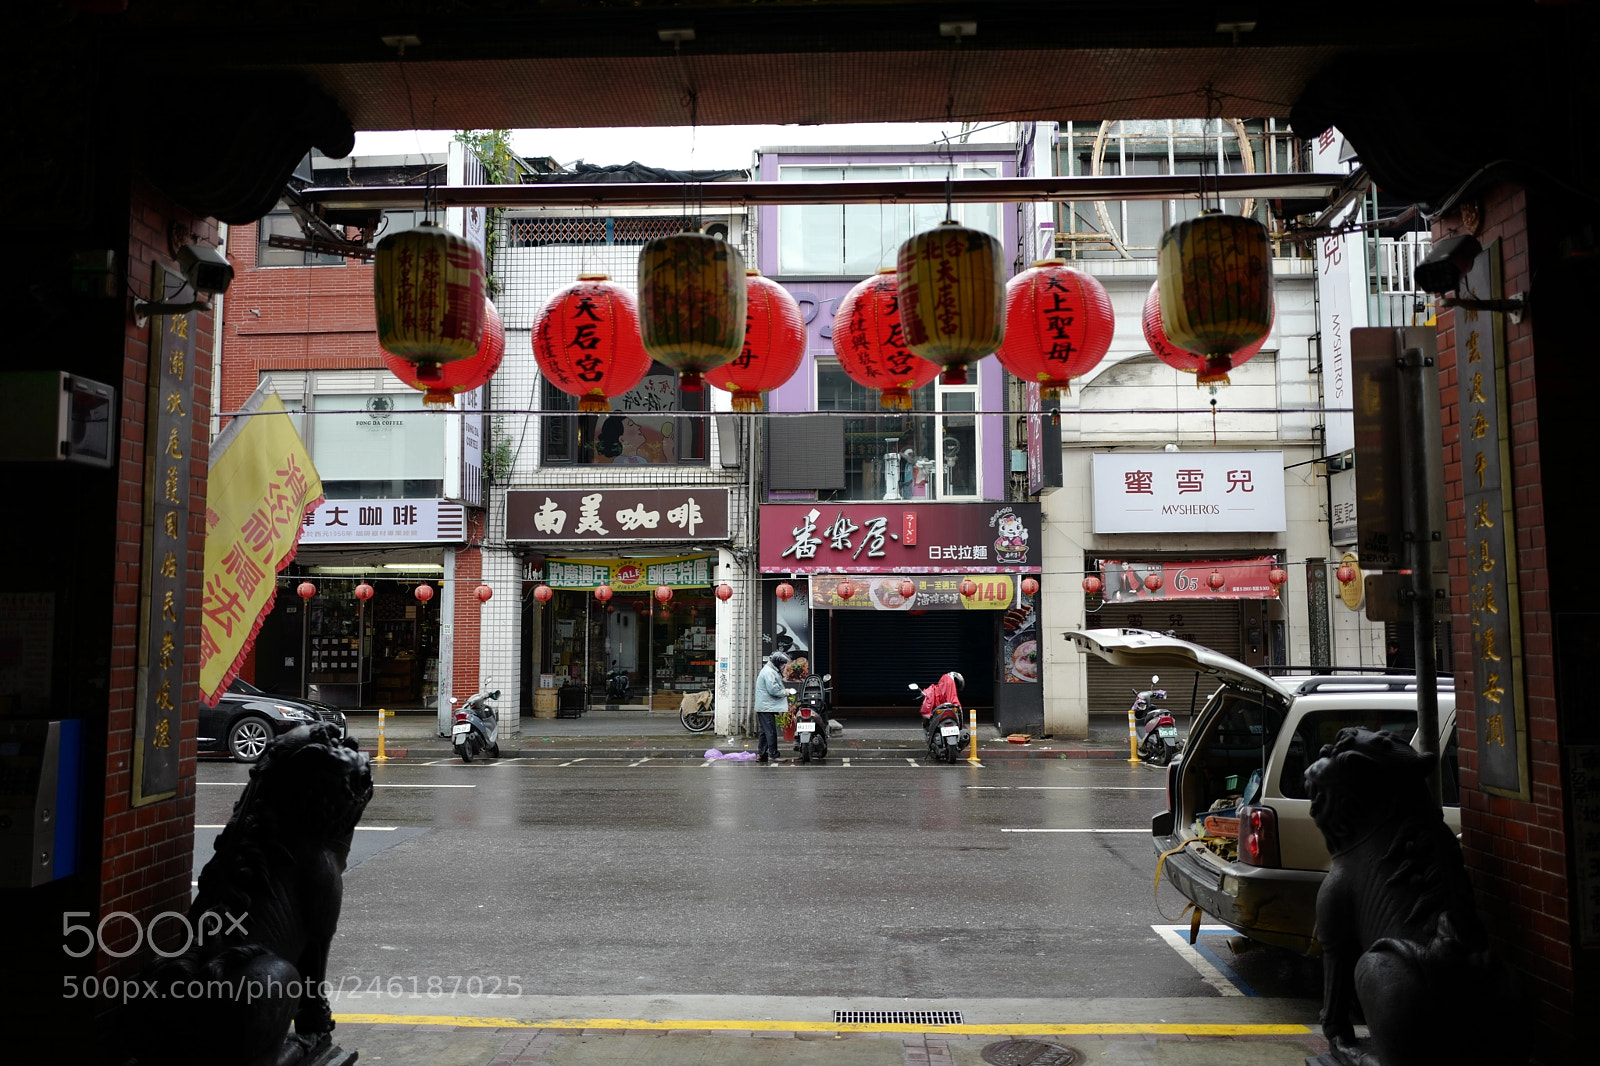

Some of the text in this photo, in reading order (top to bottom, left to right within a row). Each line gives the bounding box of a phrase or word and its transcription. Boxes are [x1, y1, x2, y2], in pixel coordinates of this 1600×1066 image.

[1043, 276, 1077, 363] 天上聖母
[567, 297, 604, 382] 天后宮
[1124, 470, 1254, 495] 蜜雪兒
[534, 493, 703, 536] 南美咖啡
[1161, 504, 1220, 515] MYSHEROS
[906, 514, 915, 544] ラーメン
[929, 545, 988, 560] 日式拉麵
[549, 562, 609, 586] 歡慶週年
[617, 568, 642, 580] SALE
[648, 558, 708, 584] 酬賓特價
